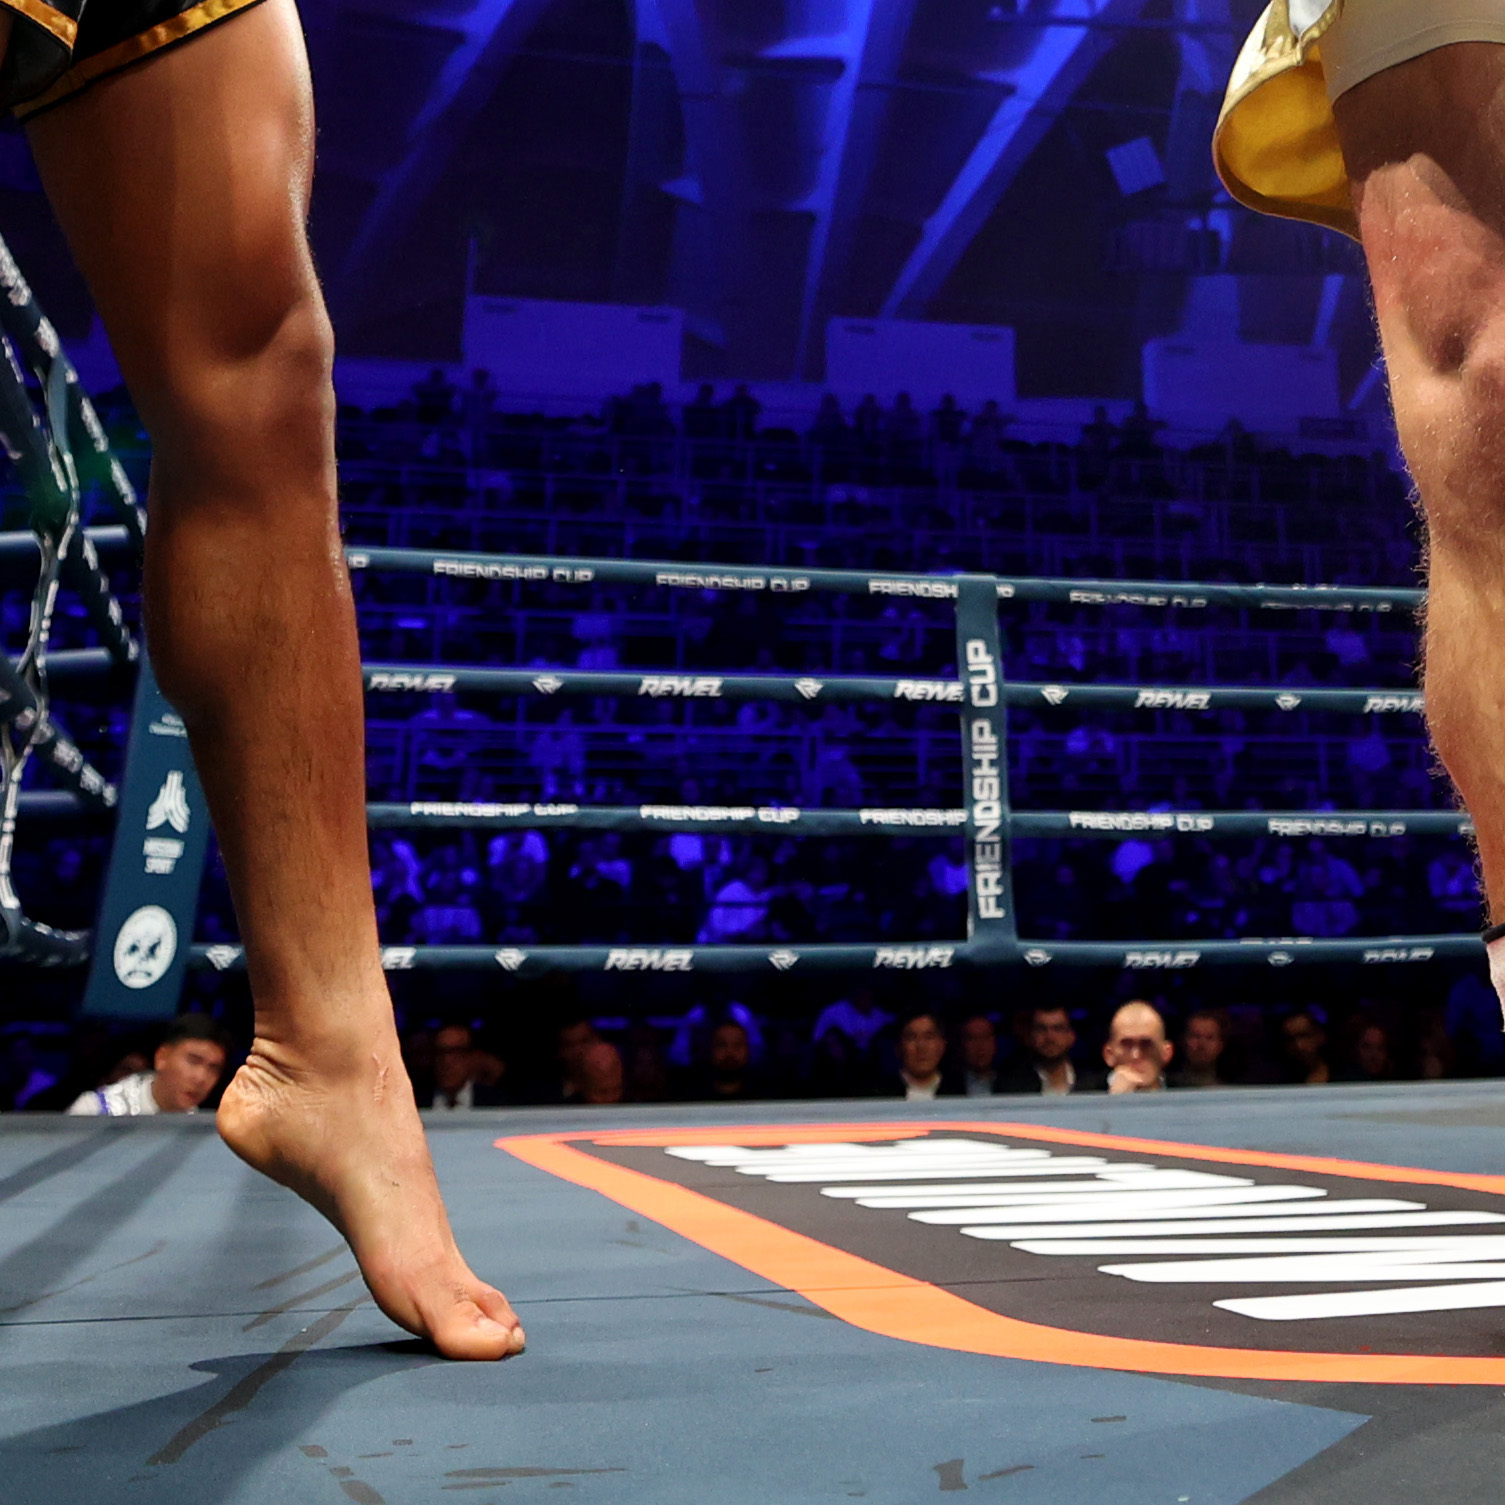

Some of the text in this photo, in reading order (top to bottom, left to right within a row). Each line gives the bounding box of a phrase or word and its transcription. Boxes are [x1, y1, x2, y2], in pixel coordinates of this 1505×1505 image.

[868, 579, 959, 599] FRIENDSH
[894, 680, 964, 702] REYVE
[966, 639, 1006, 919] FRIENDSHIP CUP
